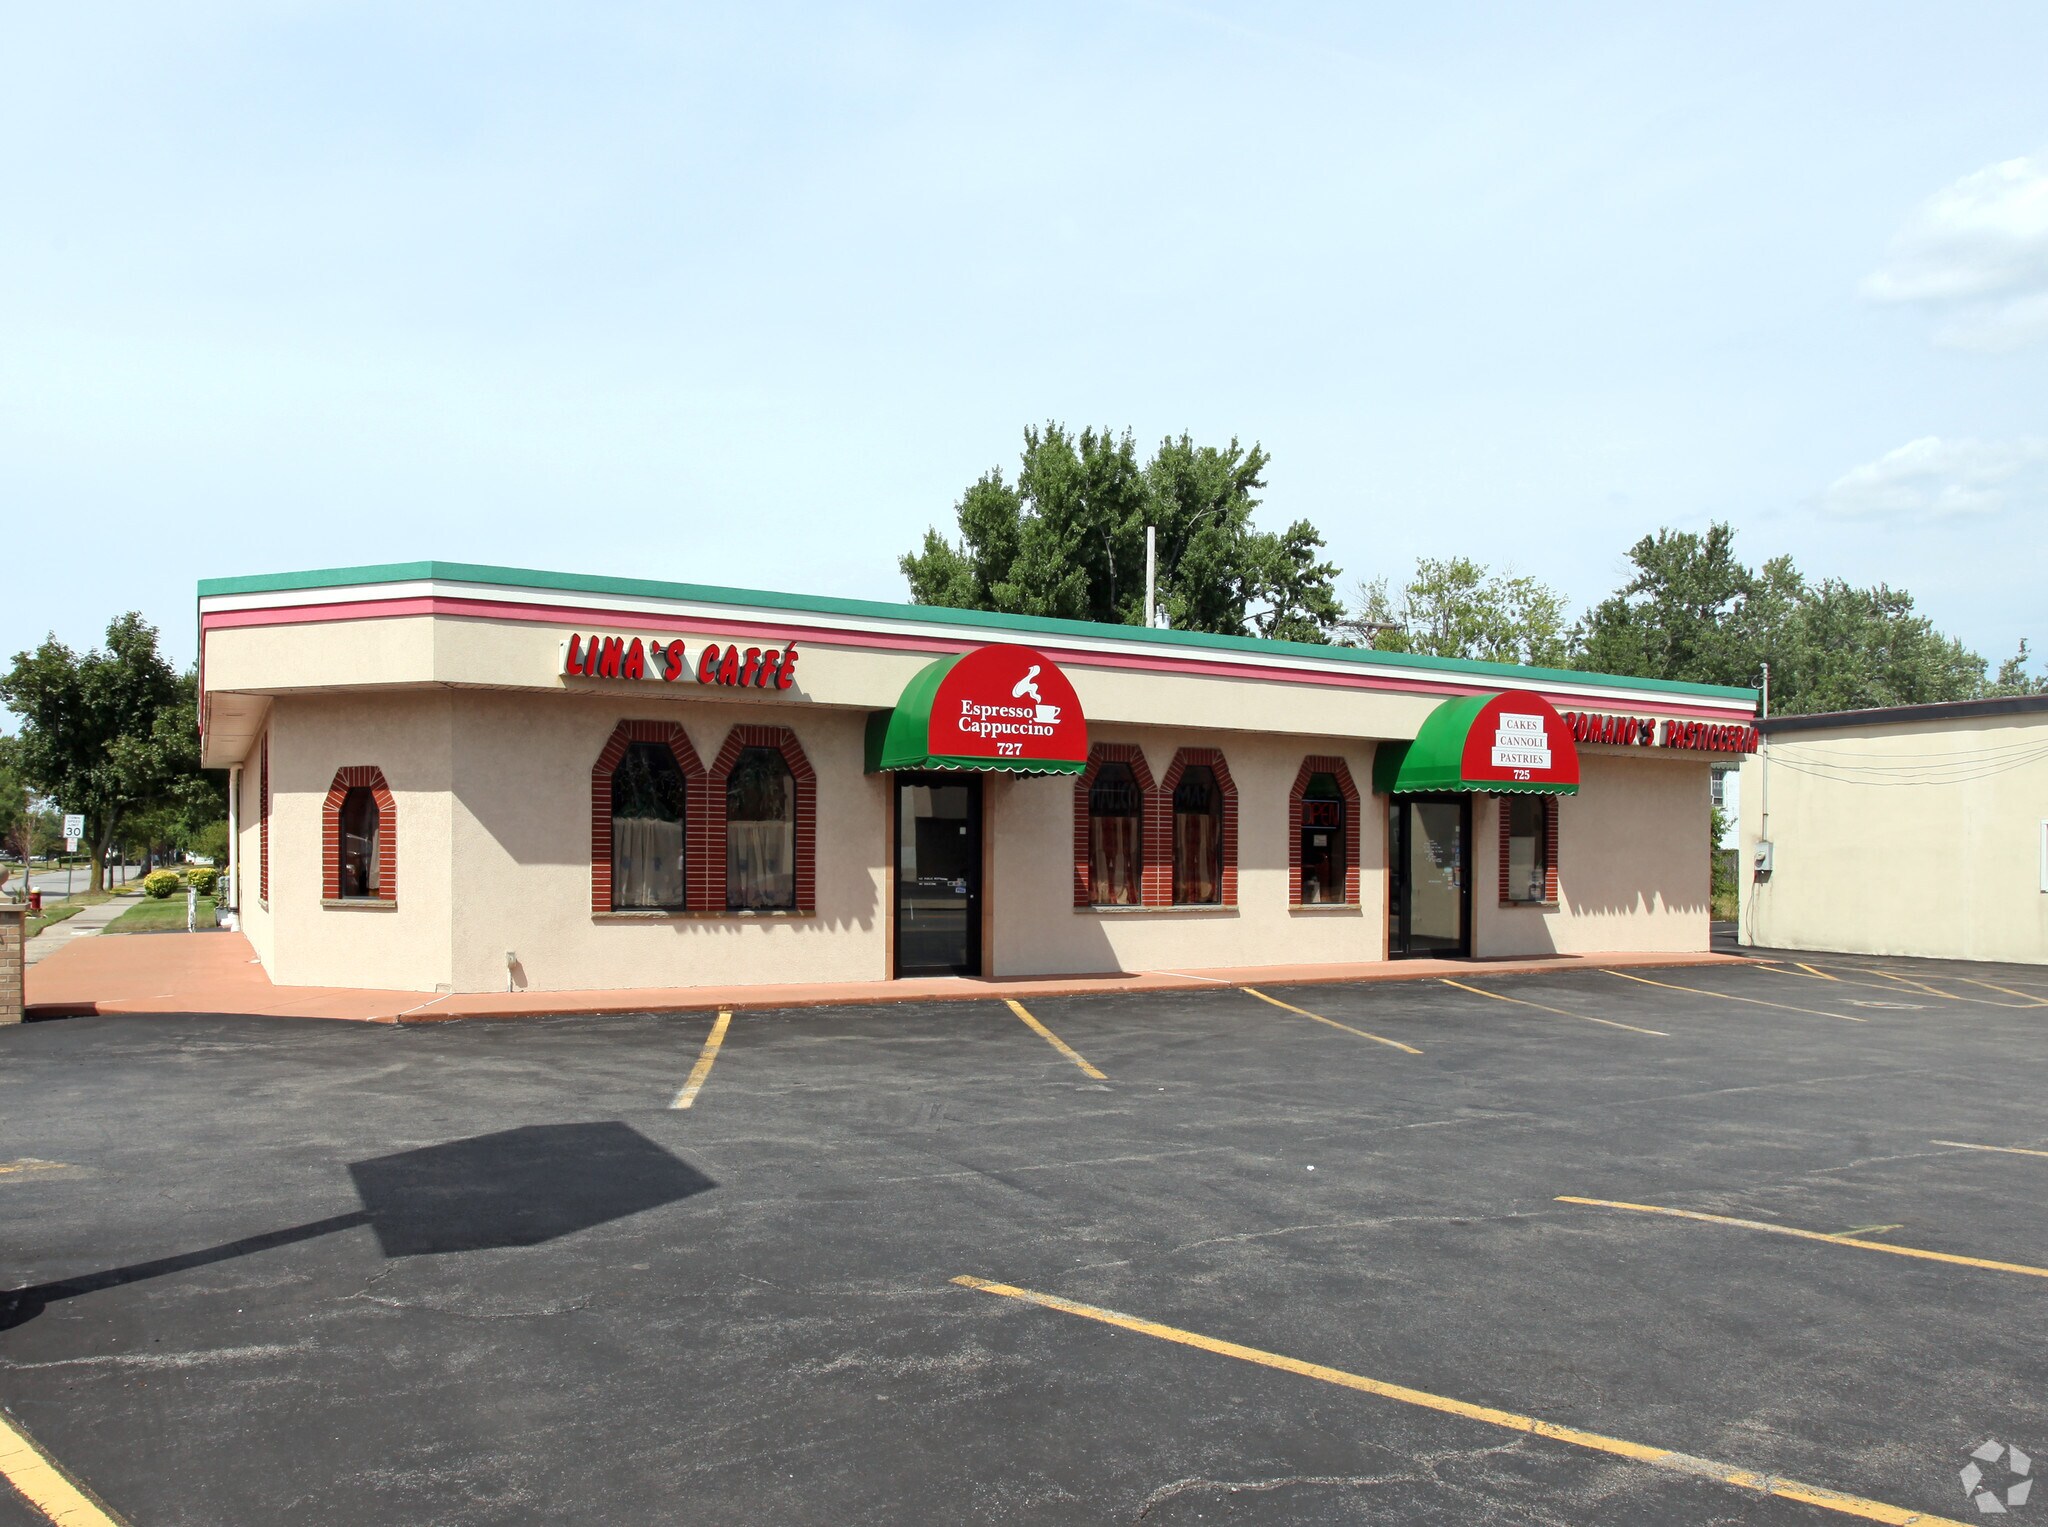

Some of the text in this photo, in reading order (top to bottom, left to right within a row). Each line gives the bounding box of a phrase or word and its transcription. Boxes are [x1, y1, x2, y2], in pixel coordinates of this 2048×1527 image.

[565, 632, 799, 690] LINA'S CAFFÉ
[960, 699, 1034, 721] Espresso
[958, 716, 1054, 738] Cappuccino
[1506, 719, 1537, 731] CAKES
[1500, 735, 1543, 748] CANNOLI
[1666, 719, 1760, 753] PASTICCERIA
[996, 742, 1023, 756] 727
[1500, 752, 1544, 765] PASTRIES
[1513, 769, 1531, 780] 725
[1302, 802, 1338, 826] OPEN
[66, 827, 81, 836] 30
